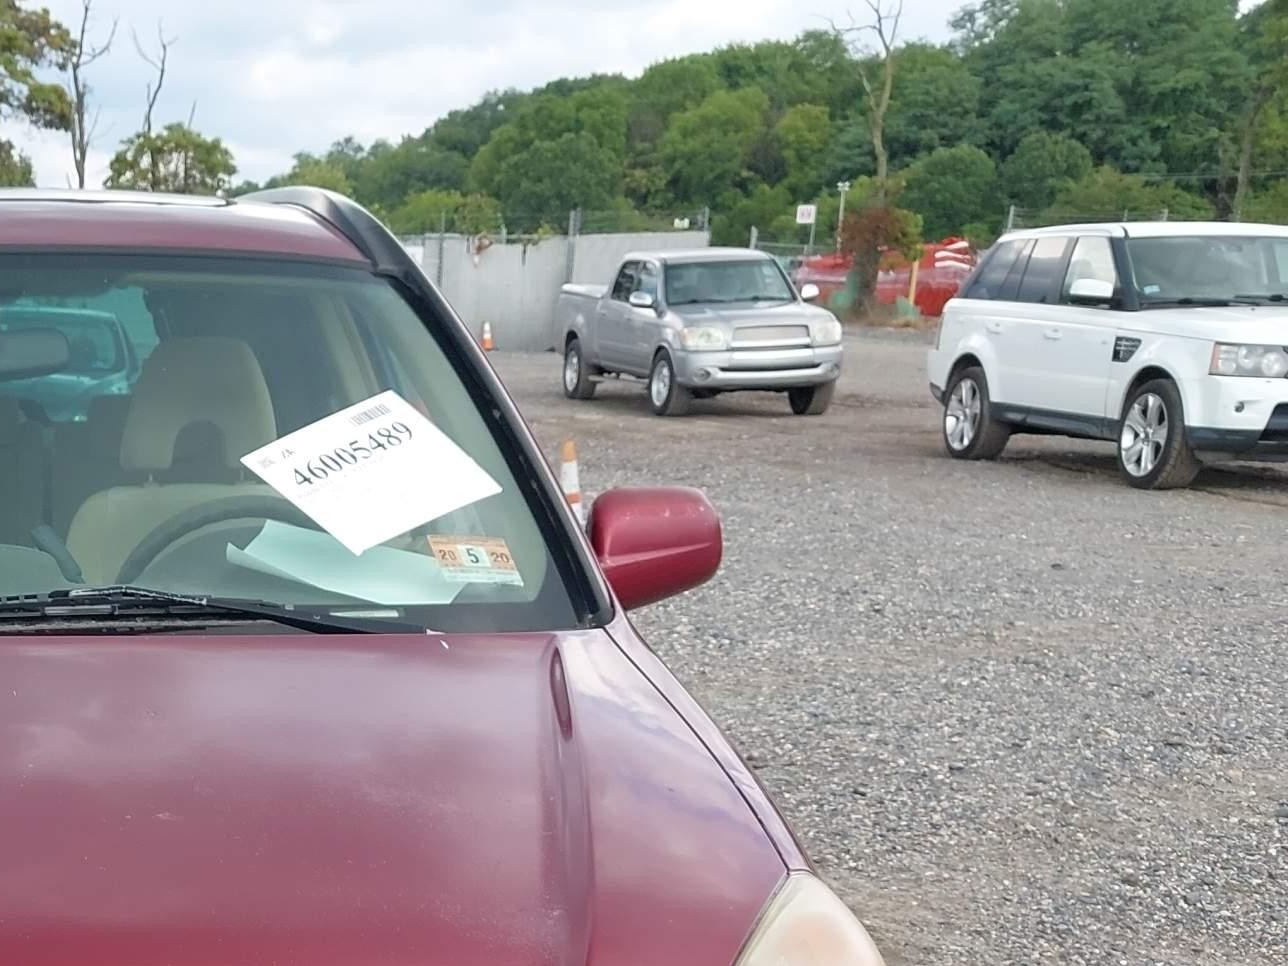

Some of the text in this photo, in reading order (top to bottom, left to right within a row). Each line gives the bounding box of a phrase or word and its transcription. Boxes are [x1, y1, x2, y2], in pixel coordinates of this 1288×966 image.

[294, 421, 413, 485] 46005489
[438, 547, 510, 564] 20 5 20
